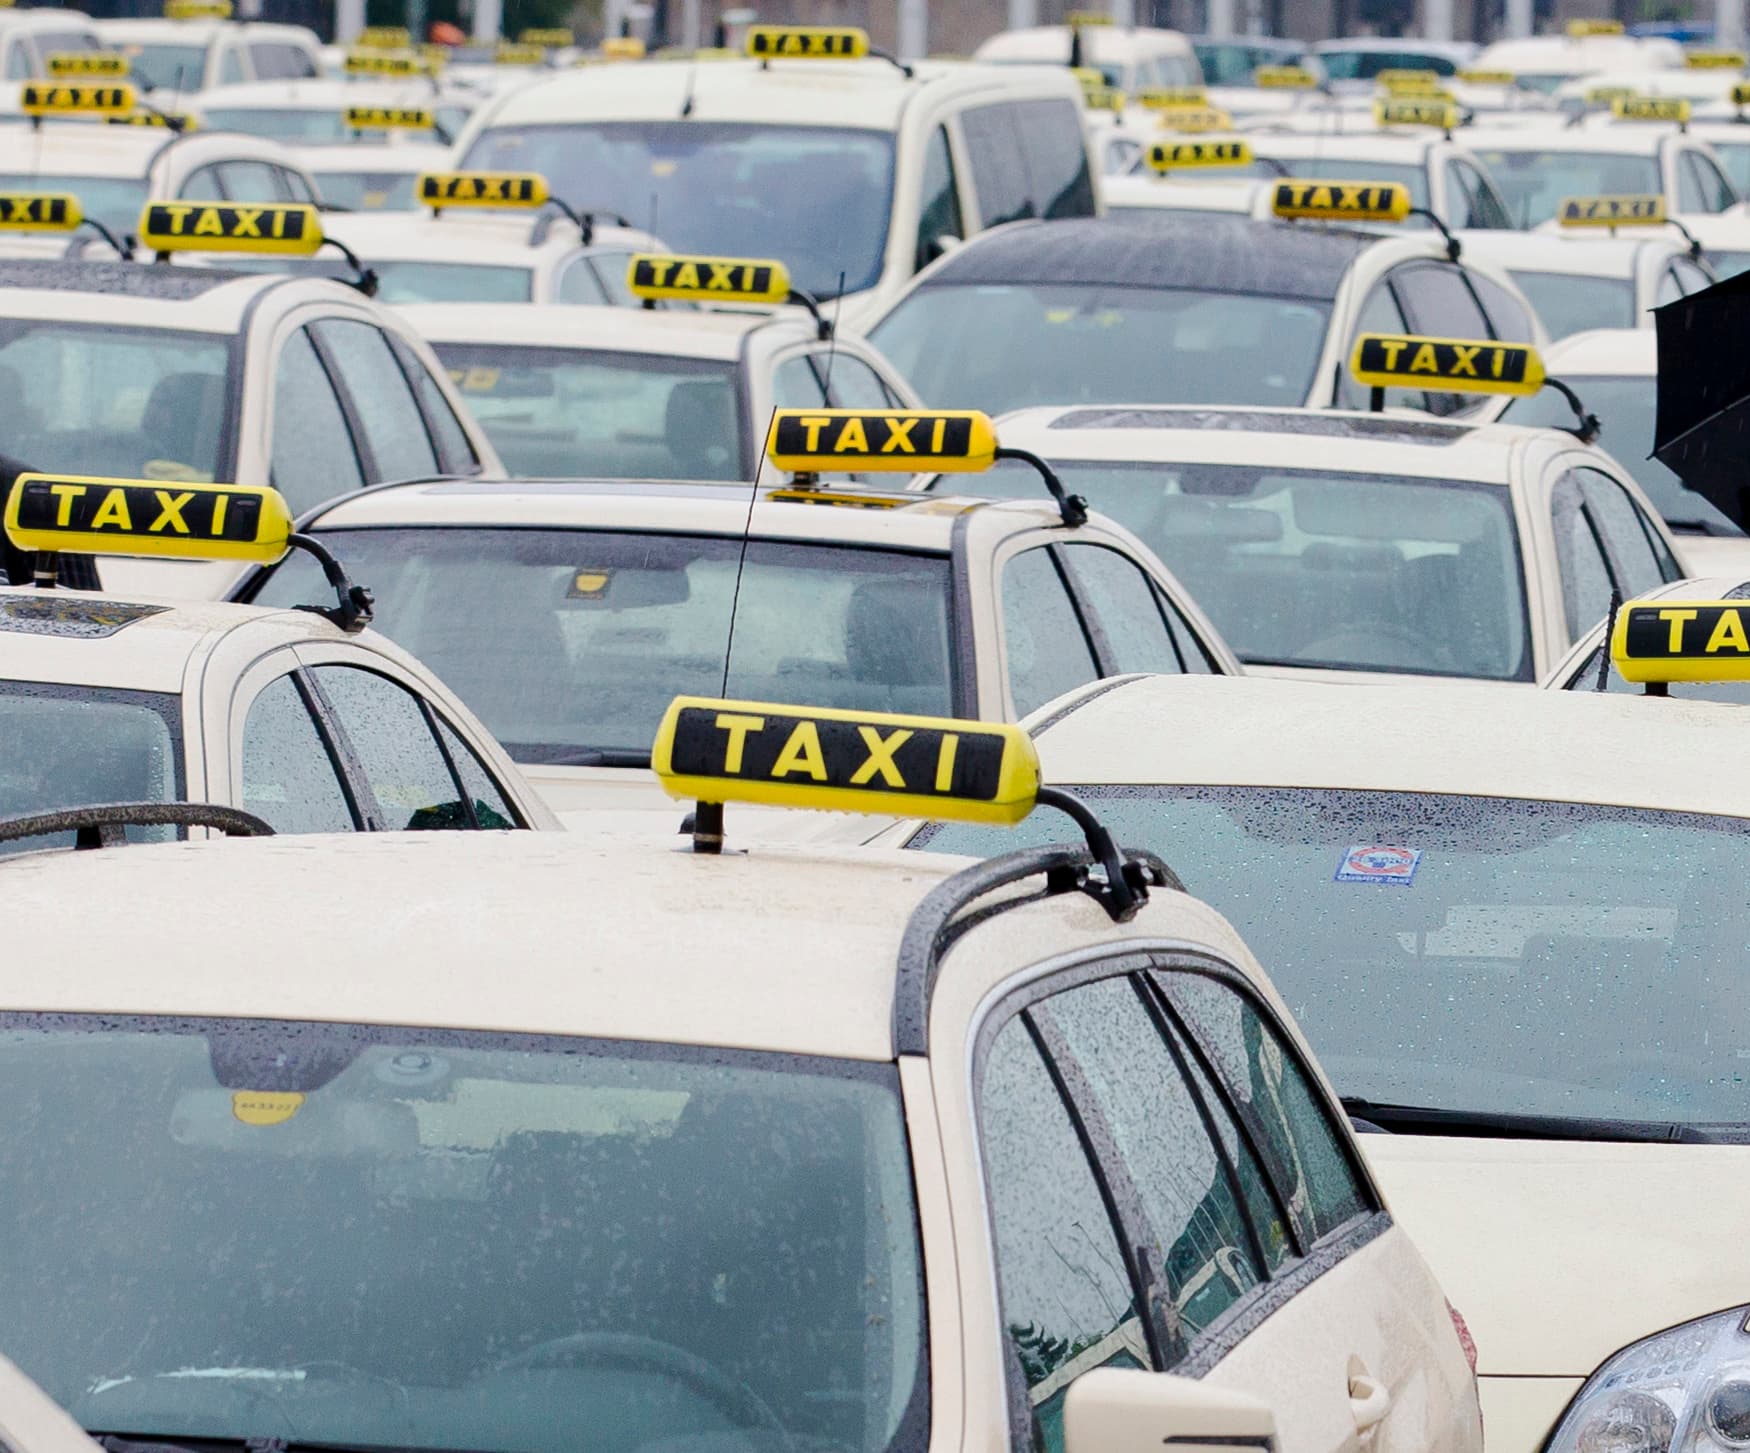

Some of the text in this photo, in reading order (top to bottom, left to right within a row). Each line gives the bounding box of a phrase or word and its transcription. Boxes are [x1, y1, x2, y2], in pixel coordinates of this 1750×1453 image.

[766, 34, 842, 53] TAXI
[36, 88, 113, 107] TAXI
[436, 179, 521, 199] TAXI
[1291, 185, 1382, 209] TAXI
[166, 208, 285, 238] TAXI
[650, 261, 756, 292] TAXI
[1381, 340, 1505, 377] TAXI
[799, 417, 946, 453] TAXI
[50, 484, 230, 534] TAXI
[715, 714, 960, 792] TAXI
